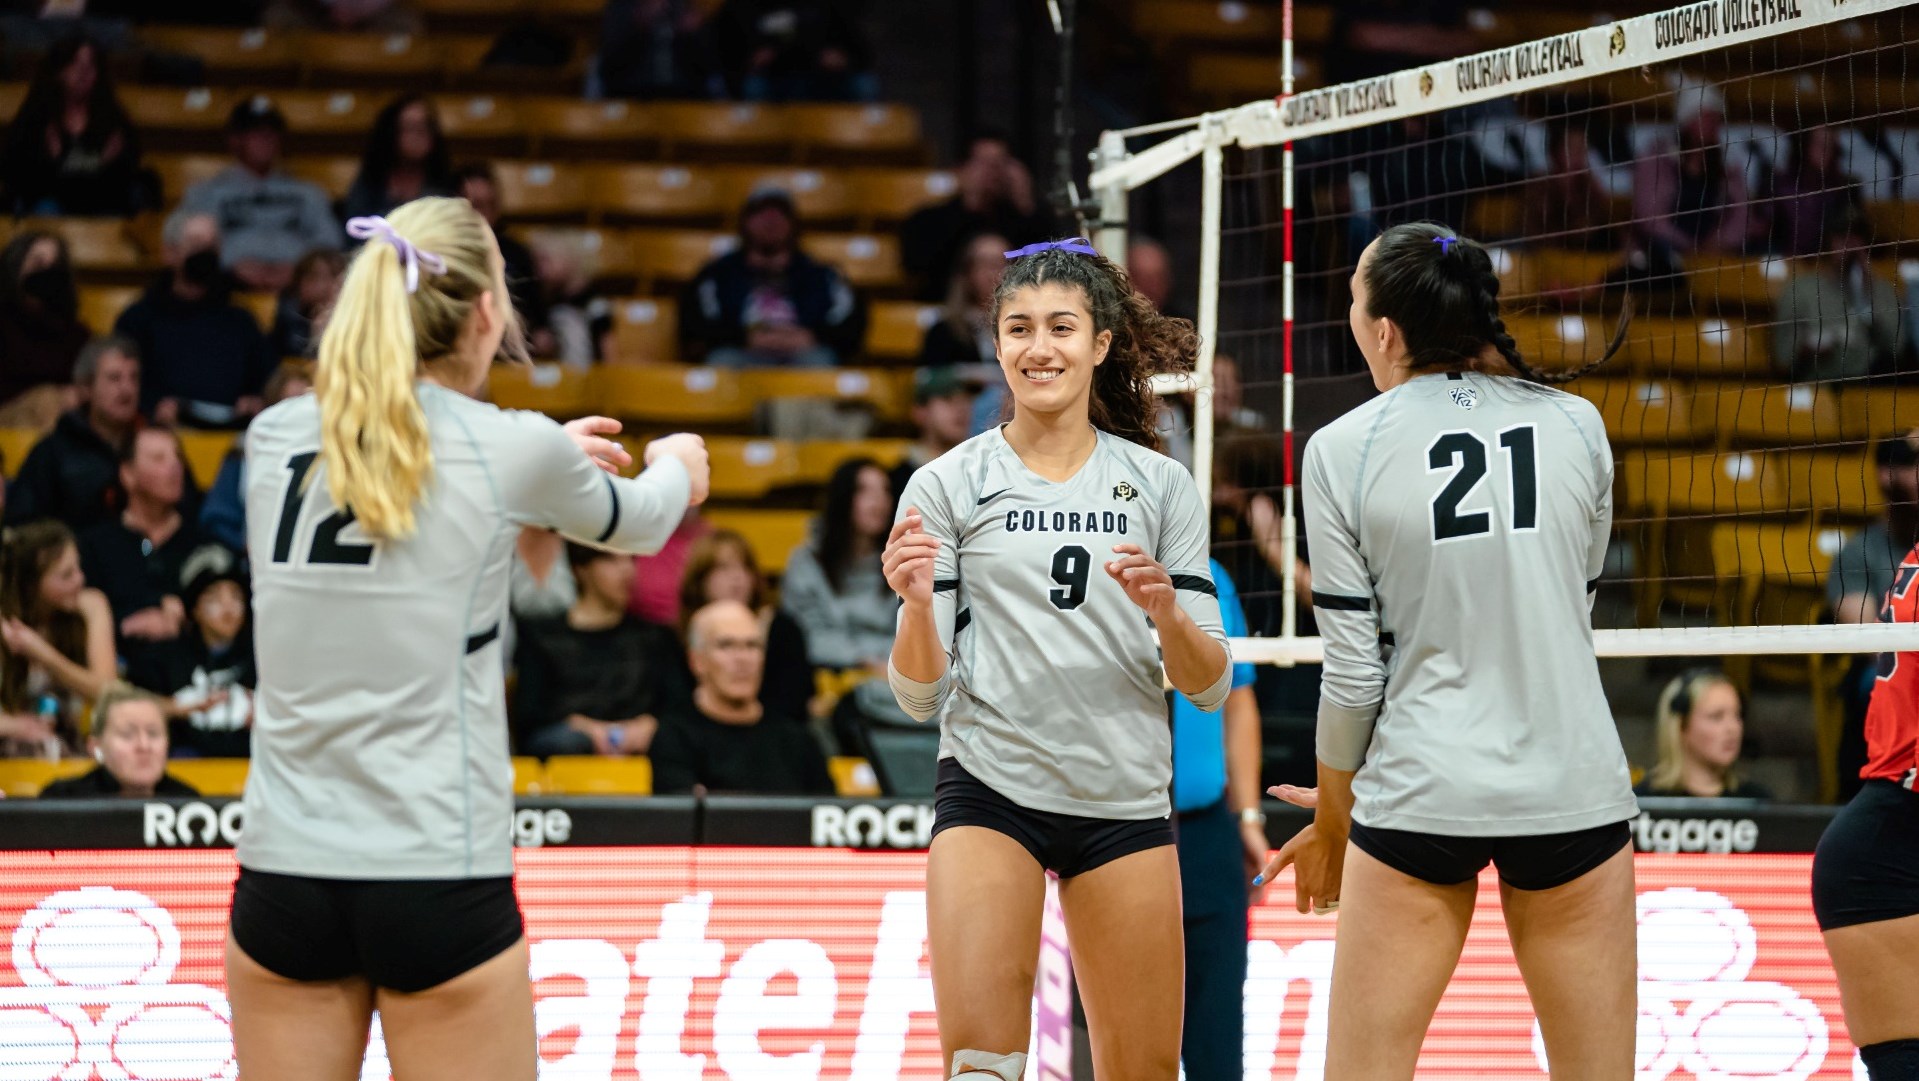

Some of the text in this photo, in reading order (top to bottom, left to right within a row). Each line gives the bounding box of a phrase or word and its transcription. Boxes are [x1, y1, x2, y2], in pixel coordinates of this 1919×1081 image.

[1655, 0, 1801, 49] COLORADO VOLLEYBALL
[1425, 422, 1540, 545] 21
[1005, 510, 1128, 535] COLORADO
[1049, 543, 1092, 612] 9
[143, 801, 244, 847] ROC
[811, 804, 936, 848] ROCK
[1630, 811, 1759, 855] tgage
[530, 891, 837, 1081] ate
